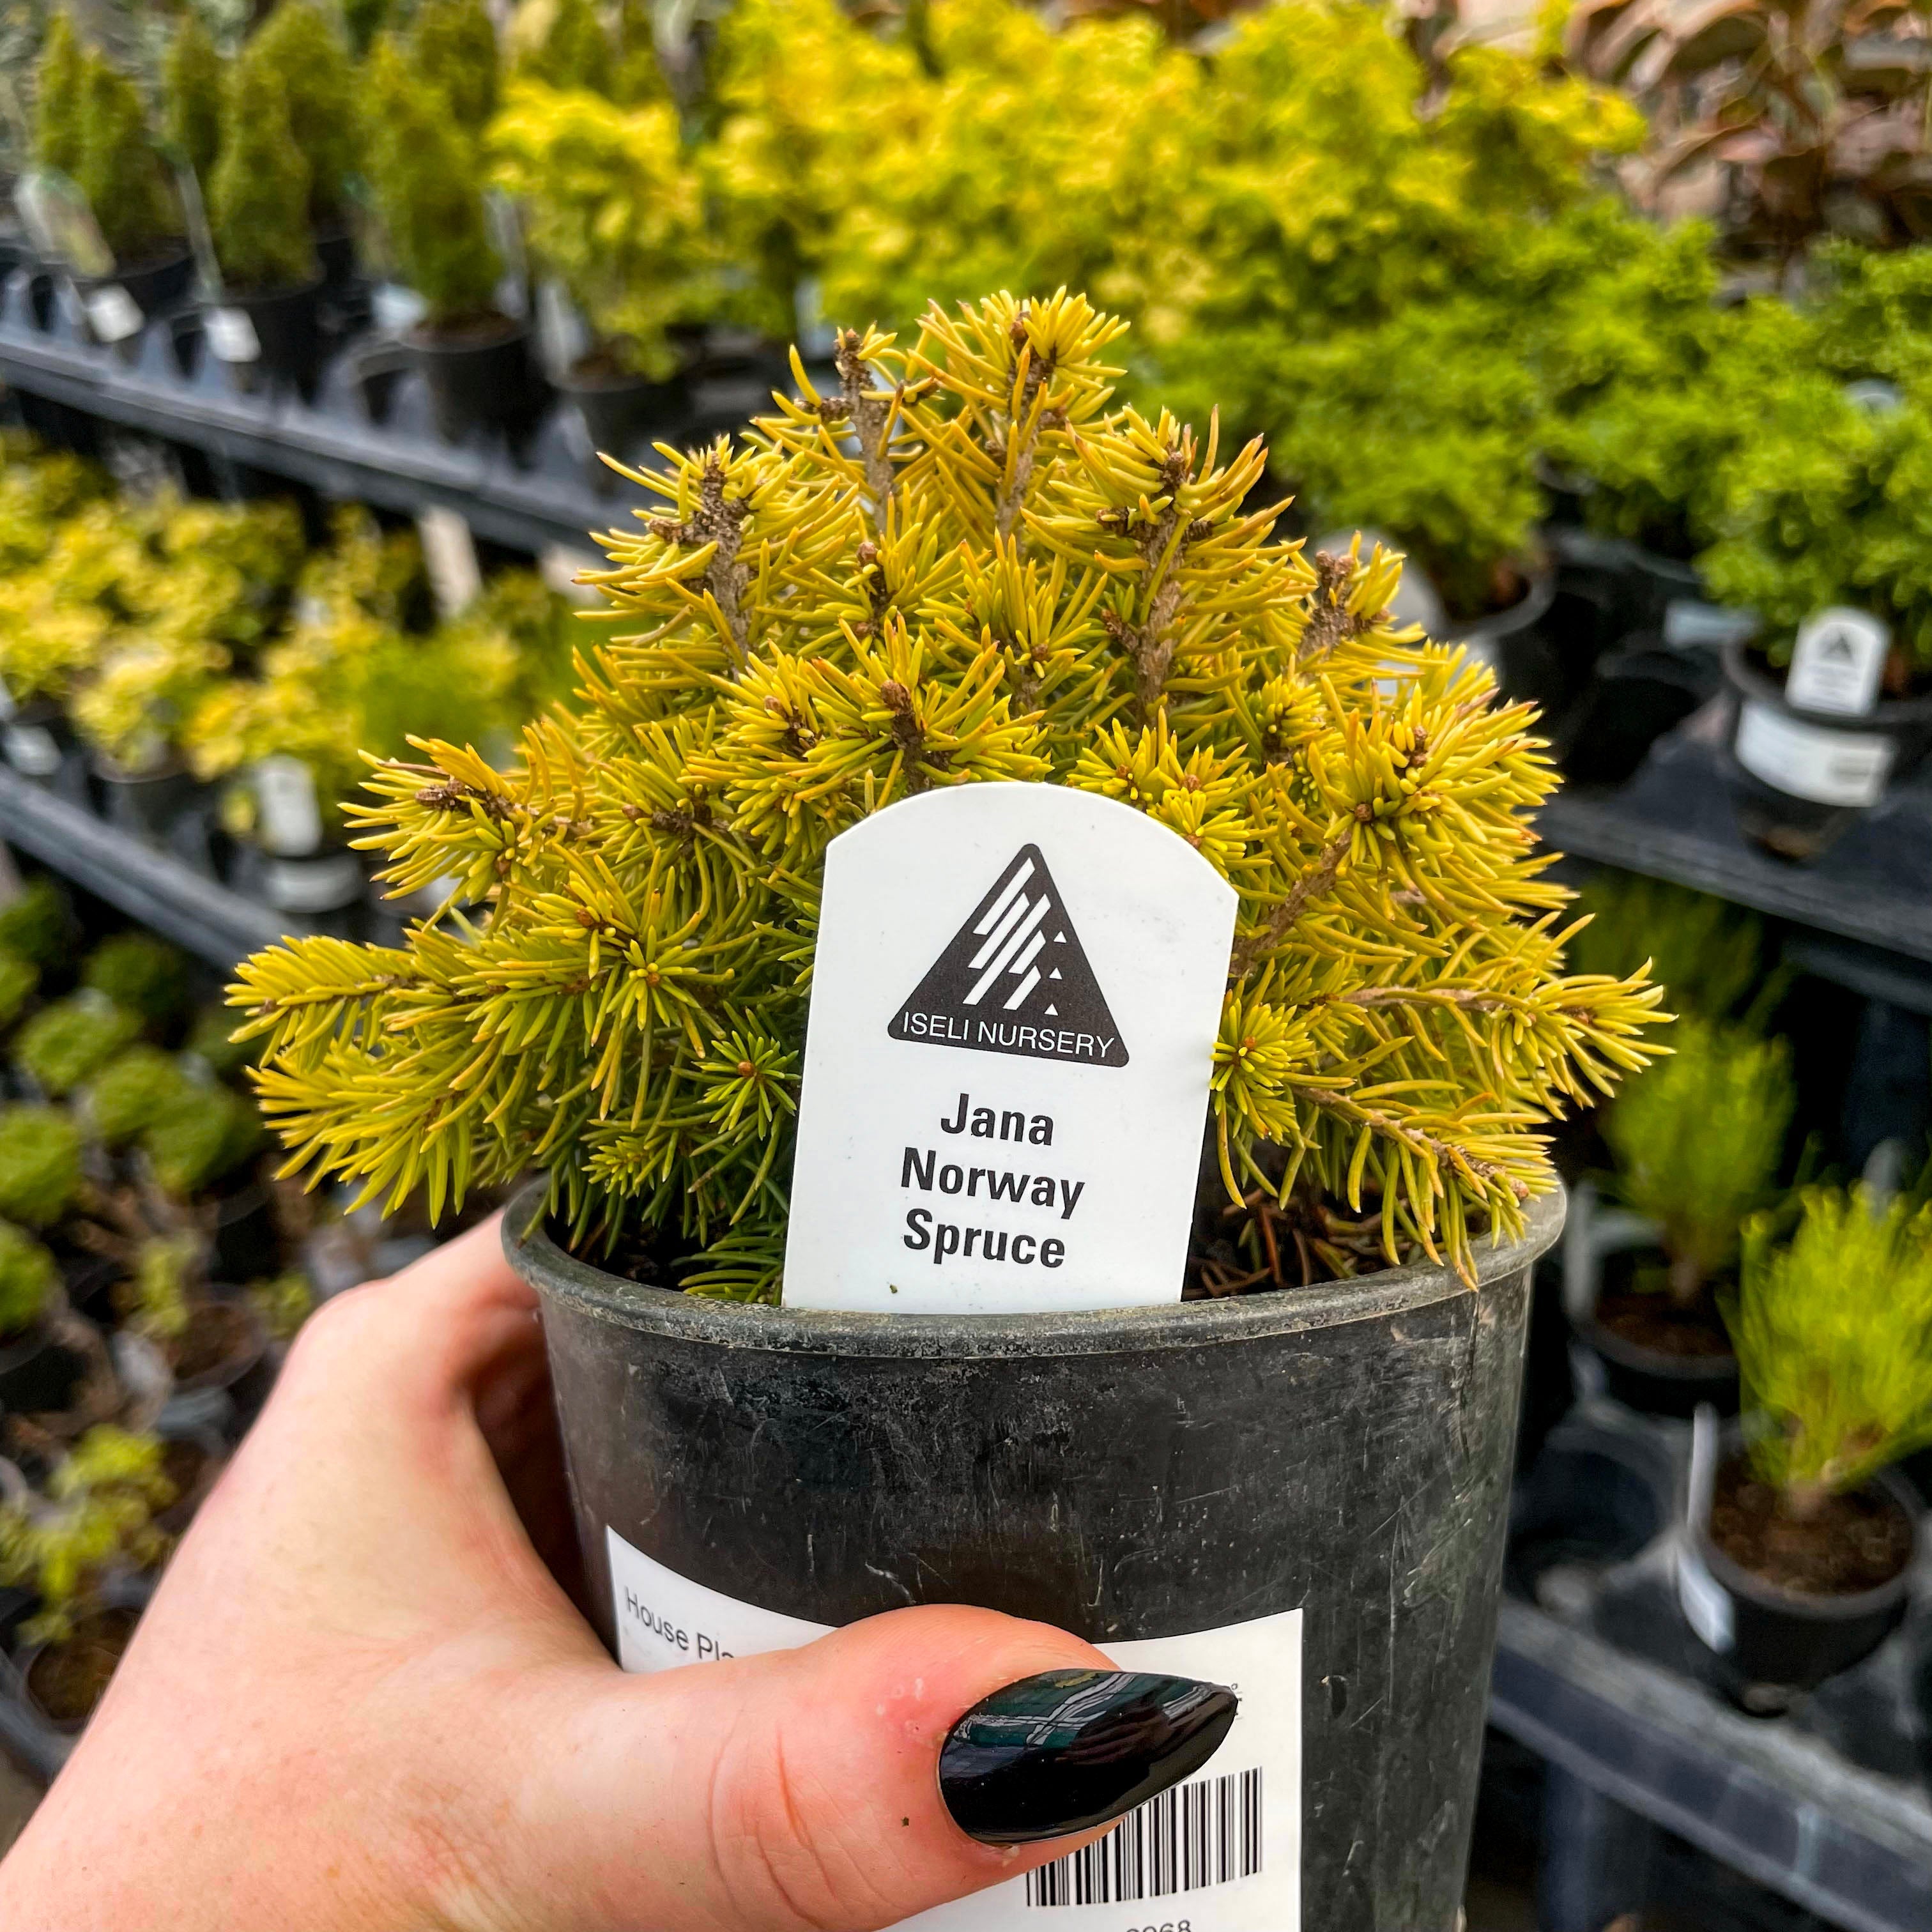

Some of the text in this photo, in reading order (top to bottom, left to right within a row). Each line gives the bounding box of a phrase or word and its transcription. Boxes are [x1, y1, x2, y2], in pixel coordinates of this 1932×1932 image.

[903, 1011, 1115, 1058] ISELI NURSERY
[940, 1092, 1054, 1146] Jana
[900, 1146, 1085, 1220] Norway
[903, 1208, 1065, 1268] Spruce
[624, 1586, 689, 1651] House
